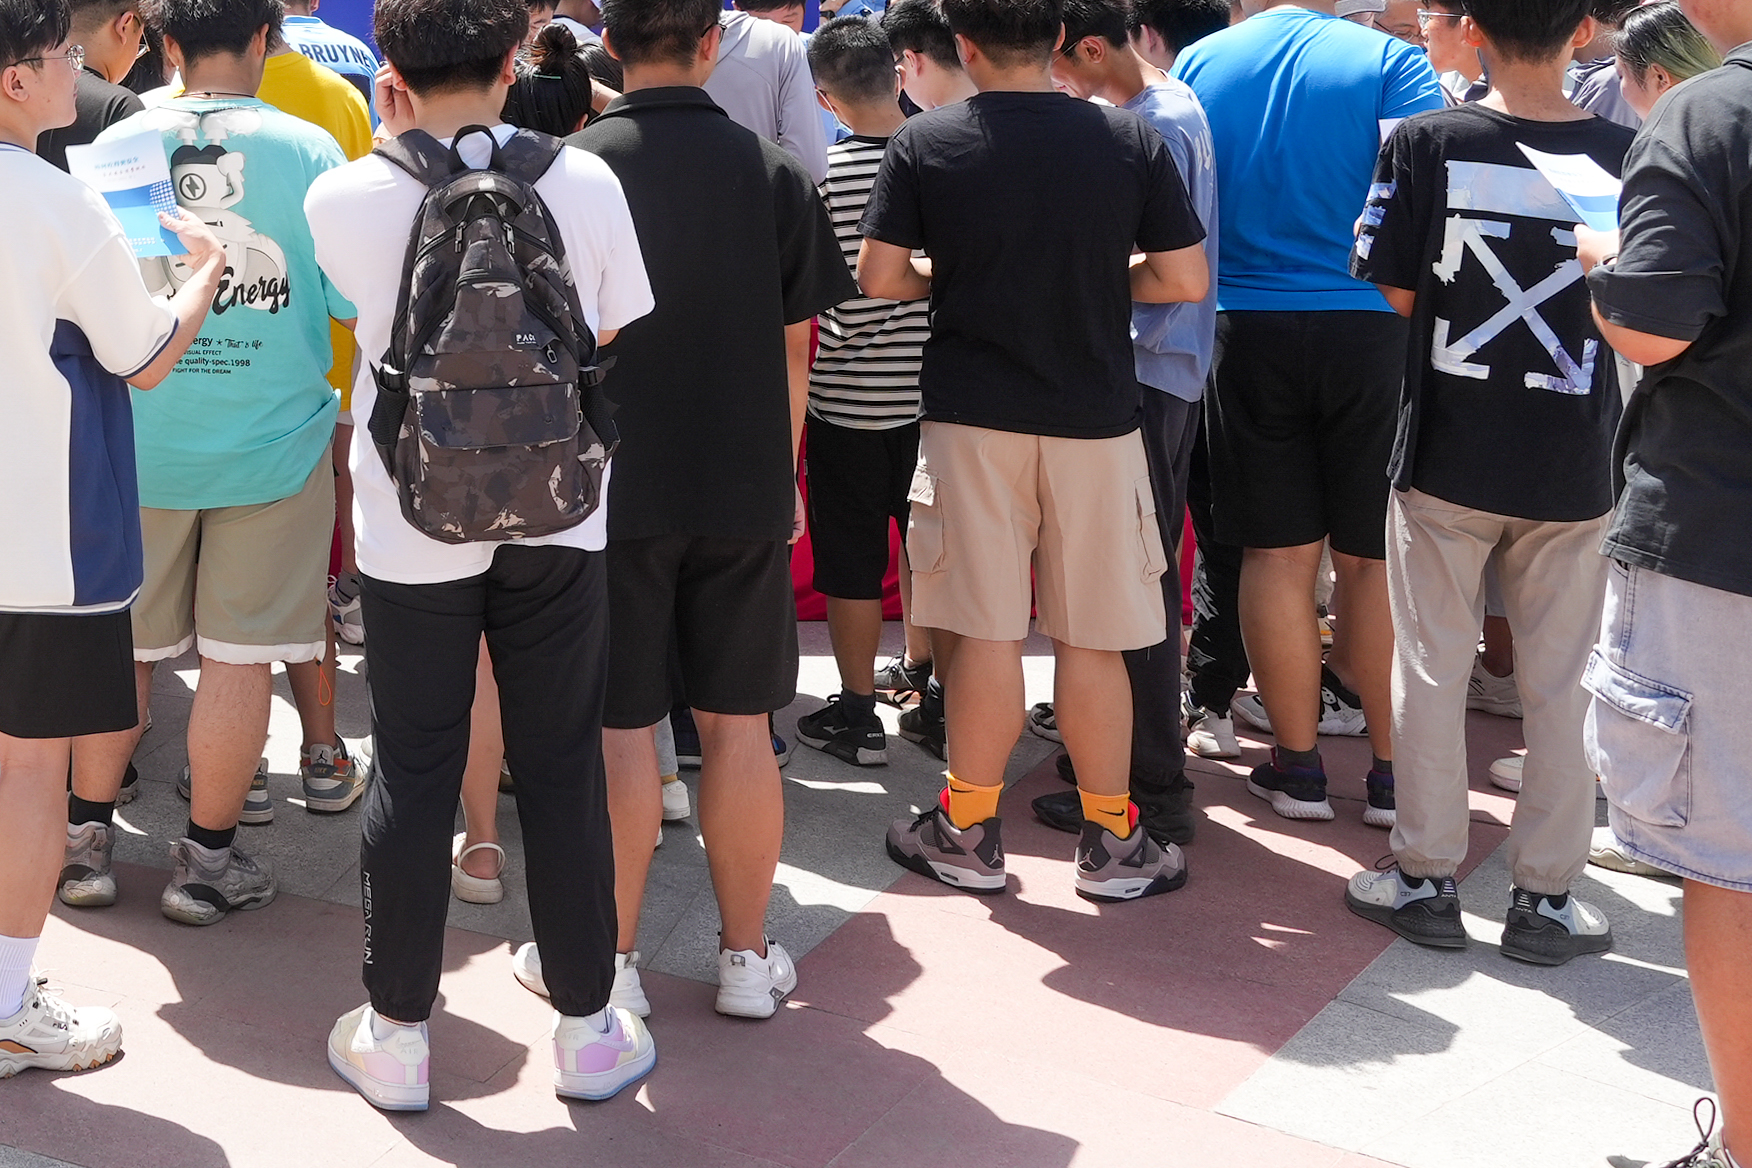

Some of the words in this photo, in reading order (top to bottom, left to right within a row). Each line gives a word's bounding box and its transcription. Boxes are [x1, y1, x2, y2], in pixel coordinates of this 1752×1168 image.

[298, 43, 371, 68] BRUYNE
[211, 265, 291, 315] Energy
[191, 337, 213, 347] ergy
